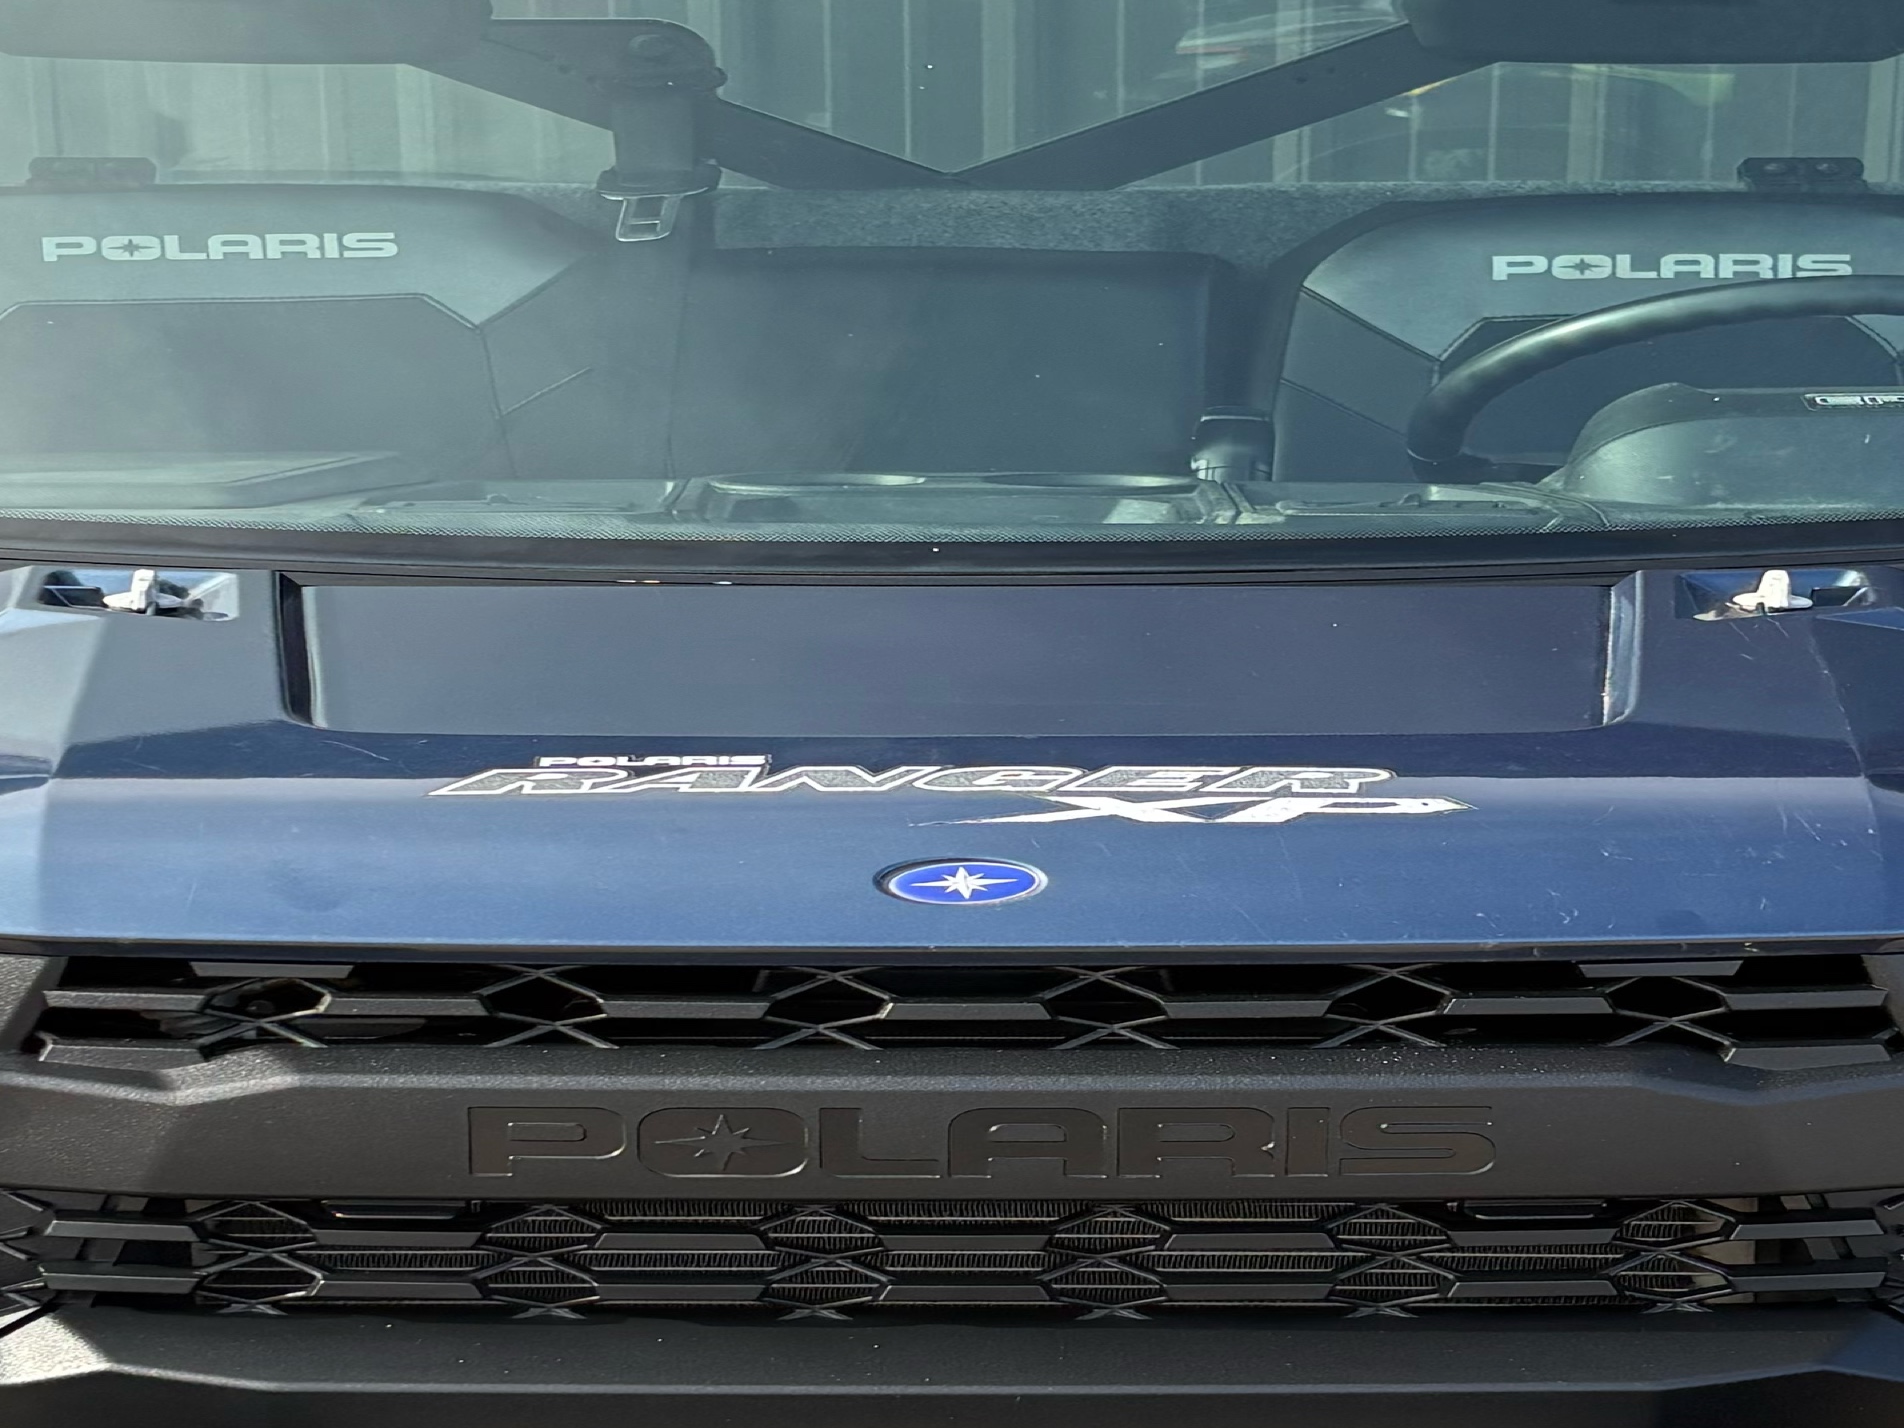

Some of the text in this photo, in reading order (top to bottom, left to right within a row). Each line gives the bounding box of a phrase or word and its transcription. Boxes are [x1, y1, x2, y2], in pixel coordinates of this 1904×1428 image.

[41, 232, 398, 262] POLARIS
[1492, 253, 1853, 281] POLARIS
[538, 755, 767, 767] POLARIS
[427, 765, 1396, 796] RANGER
[910, 795, 1478, 824] XP
[466, 1105, 1497, 1178] POLARIS
